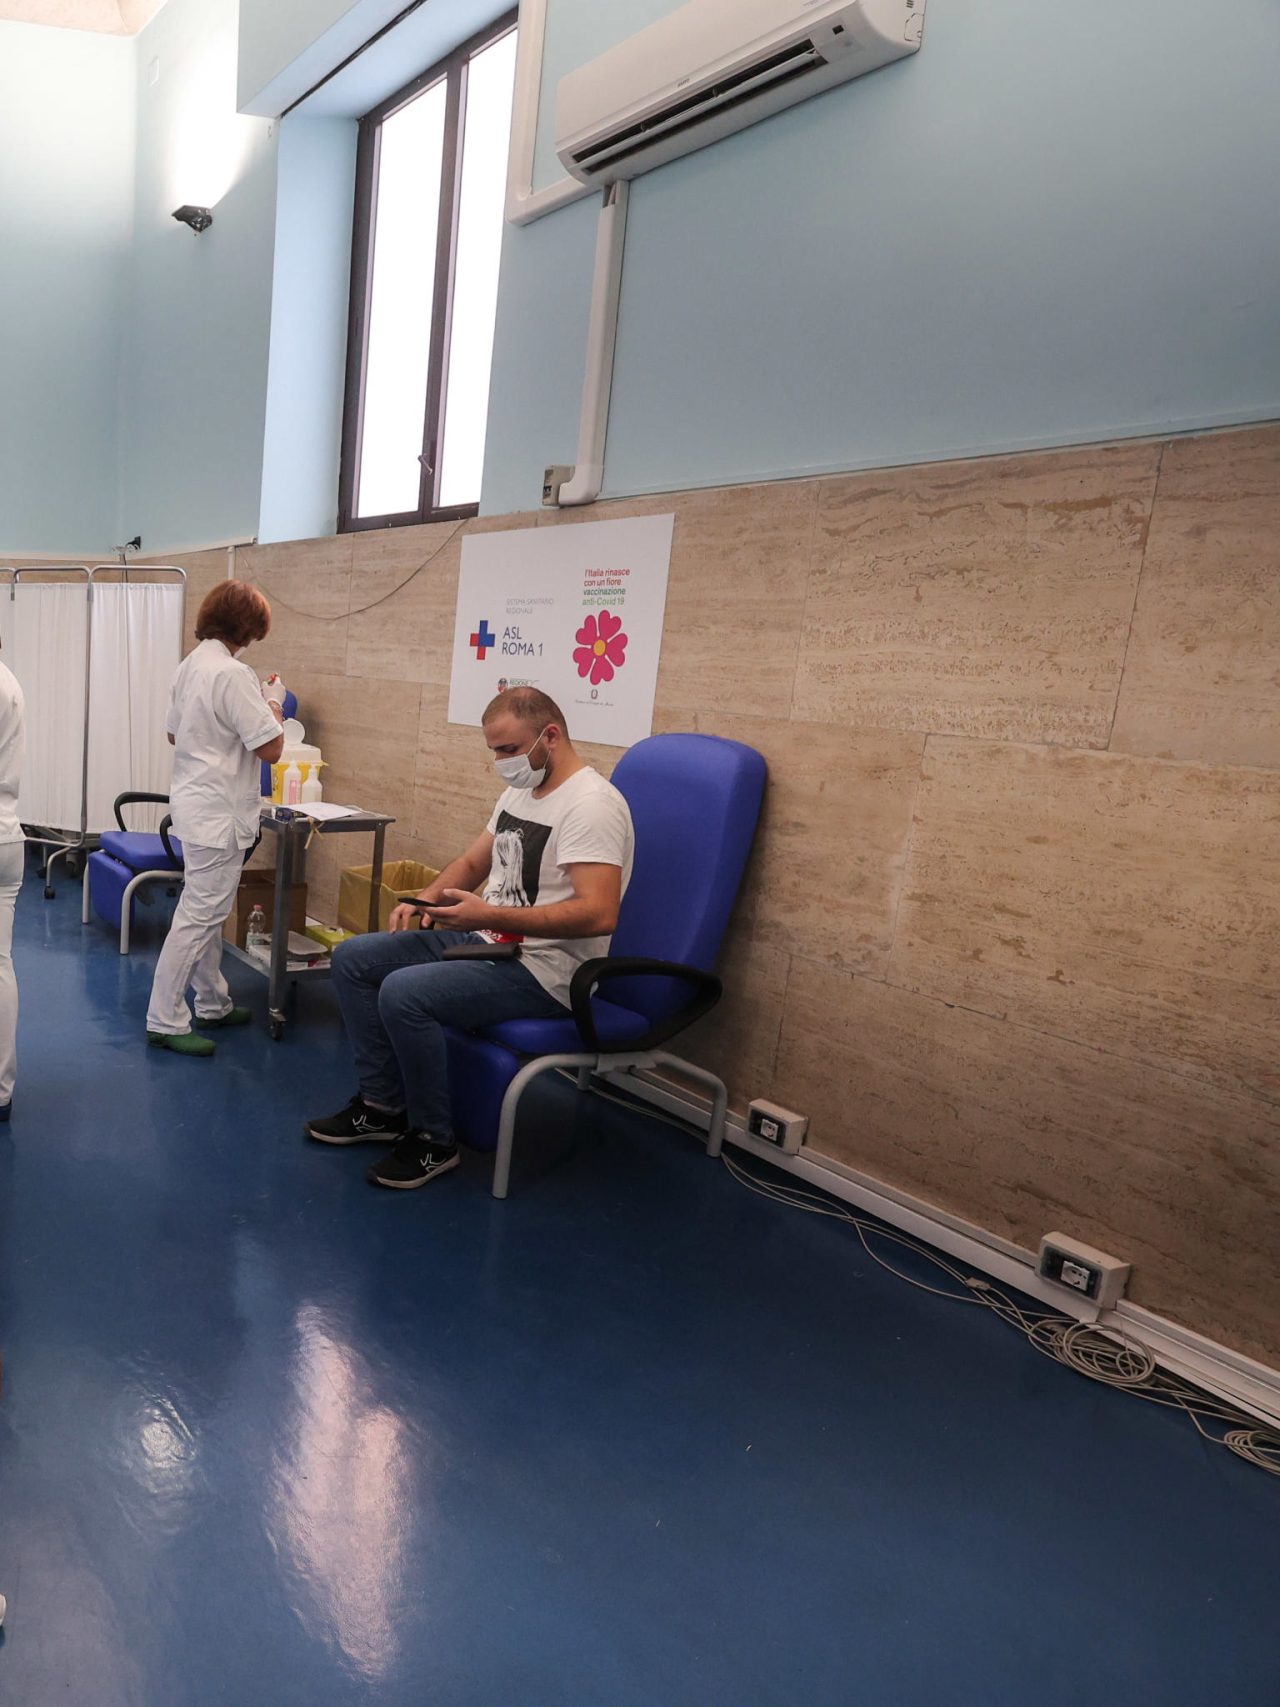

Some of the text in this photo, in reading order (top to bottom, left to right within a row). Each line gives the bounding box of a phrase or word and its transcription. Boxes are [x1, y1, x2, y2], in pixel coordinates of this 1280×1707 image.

[583, 587, 626, 596] vaccinazione
[502, 626, 522, 640] ASL
[502, 642, 543, 656] ROMA 1
